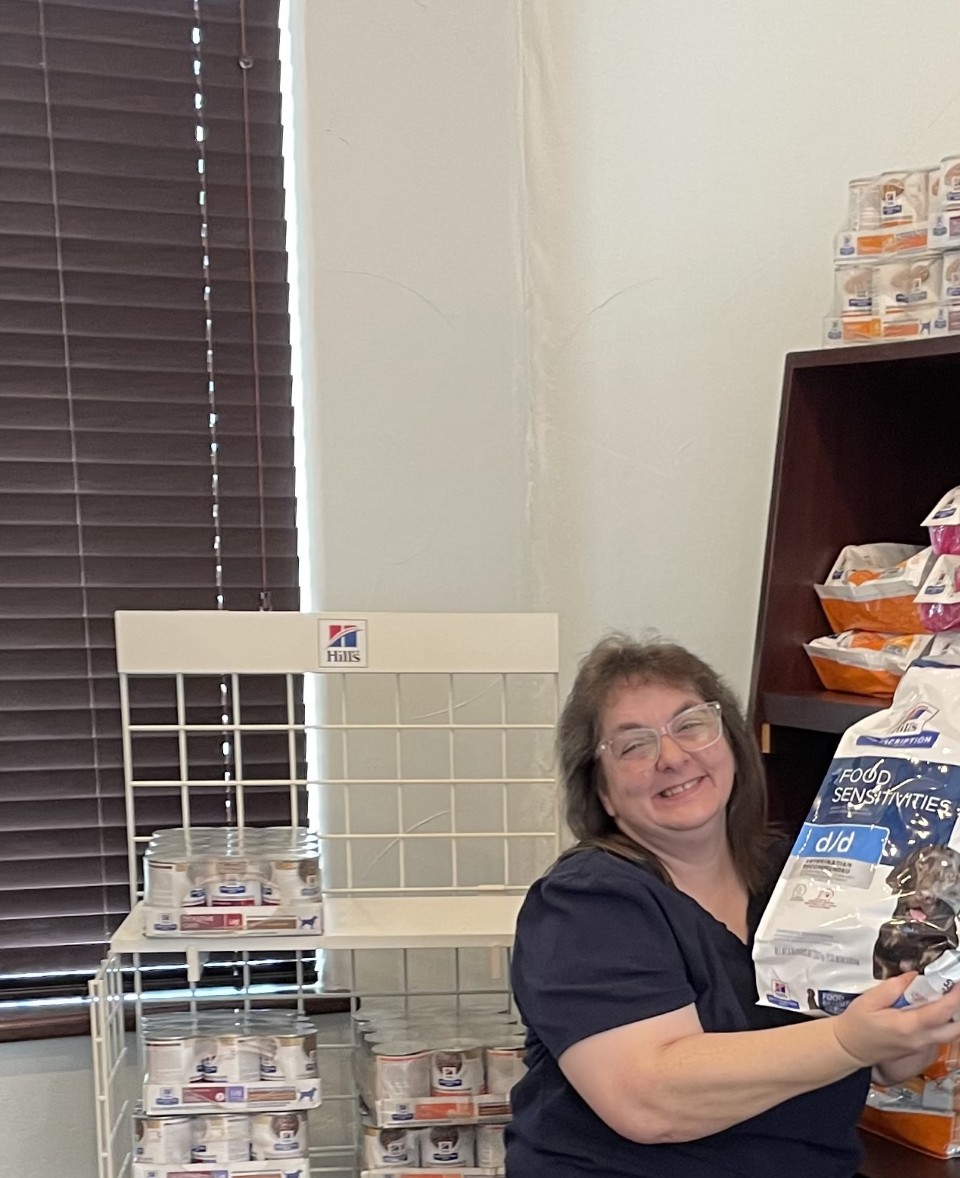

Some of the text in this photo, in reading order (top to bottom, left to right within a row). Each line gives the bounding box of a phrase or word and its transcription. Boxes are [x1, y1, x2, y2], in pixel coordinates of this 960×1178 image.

[326, 649, 361, 664] Hill's
[839, 767, 891, 786] FOOD
[831, 786, 952, 815] SENSITIVITIES
[815, 831, 855, 854] d/d
